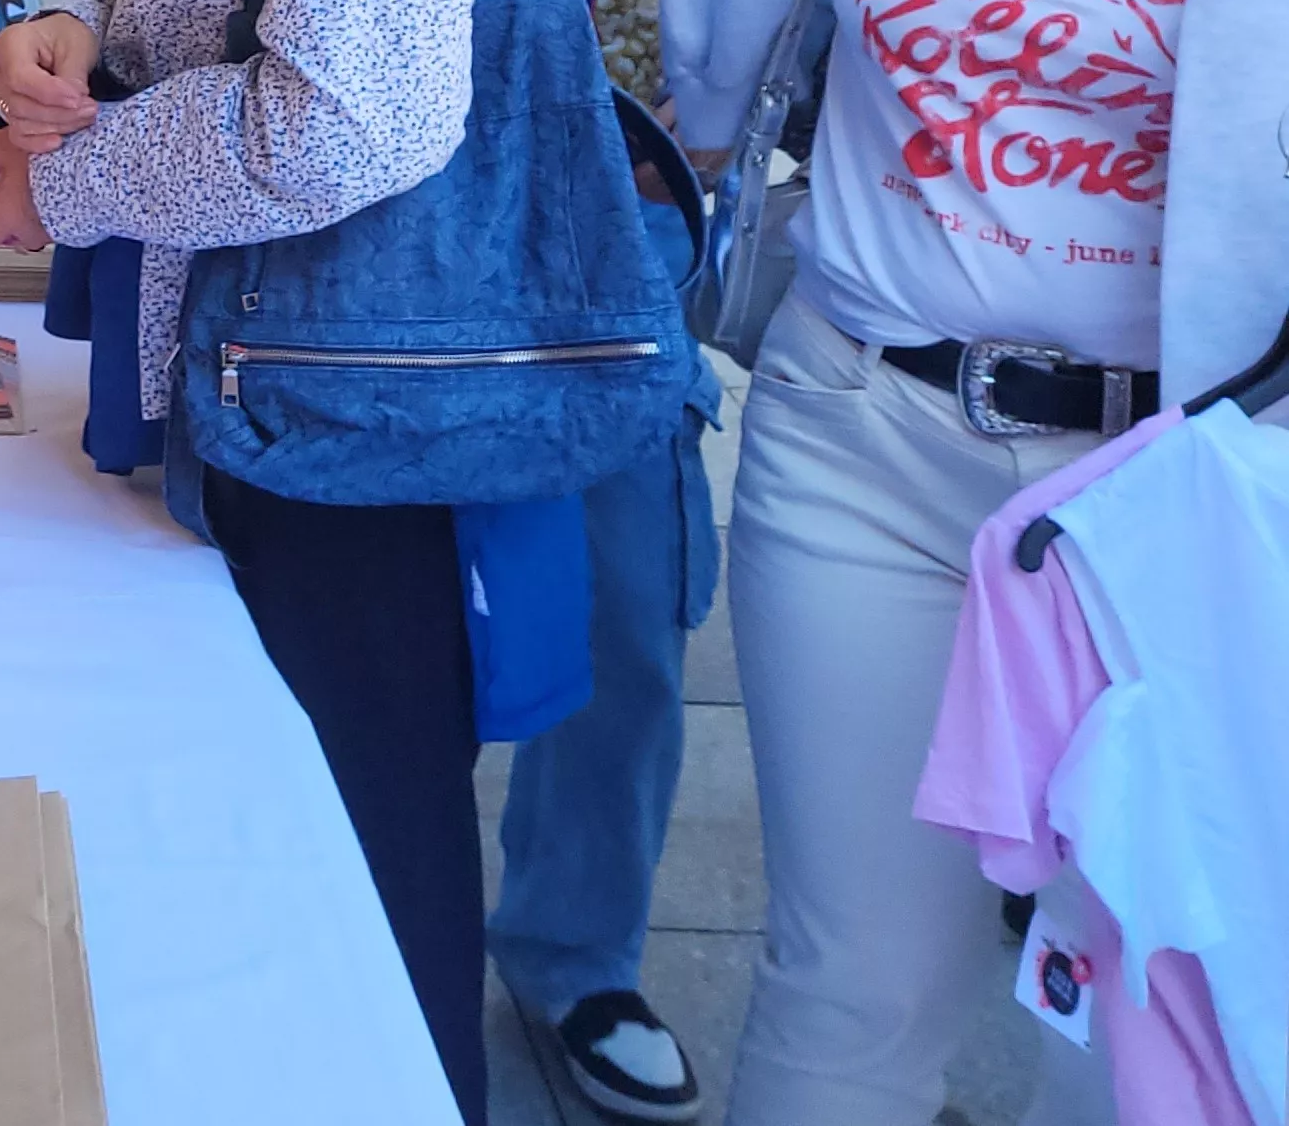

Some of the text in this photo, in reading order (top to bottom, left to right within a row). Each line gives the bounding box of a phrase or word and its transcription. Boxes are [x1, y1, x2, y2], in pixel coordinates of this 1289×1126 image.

[899, 79, 1168, 202] Stone
[979, 225, 1032, 255] city
[1063, 239, 1134, 266] june
